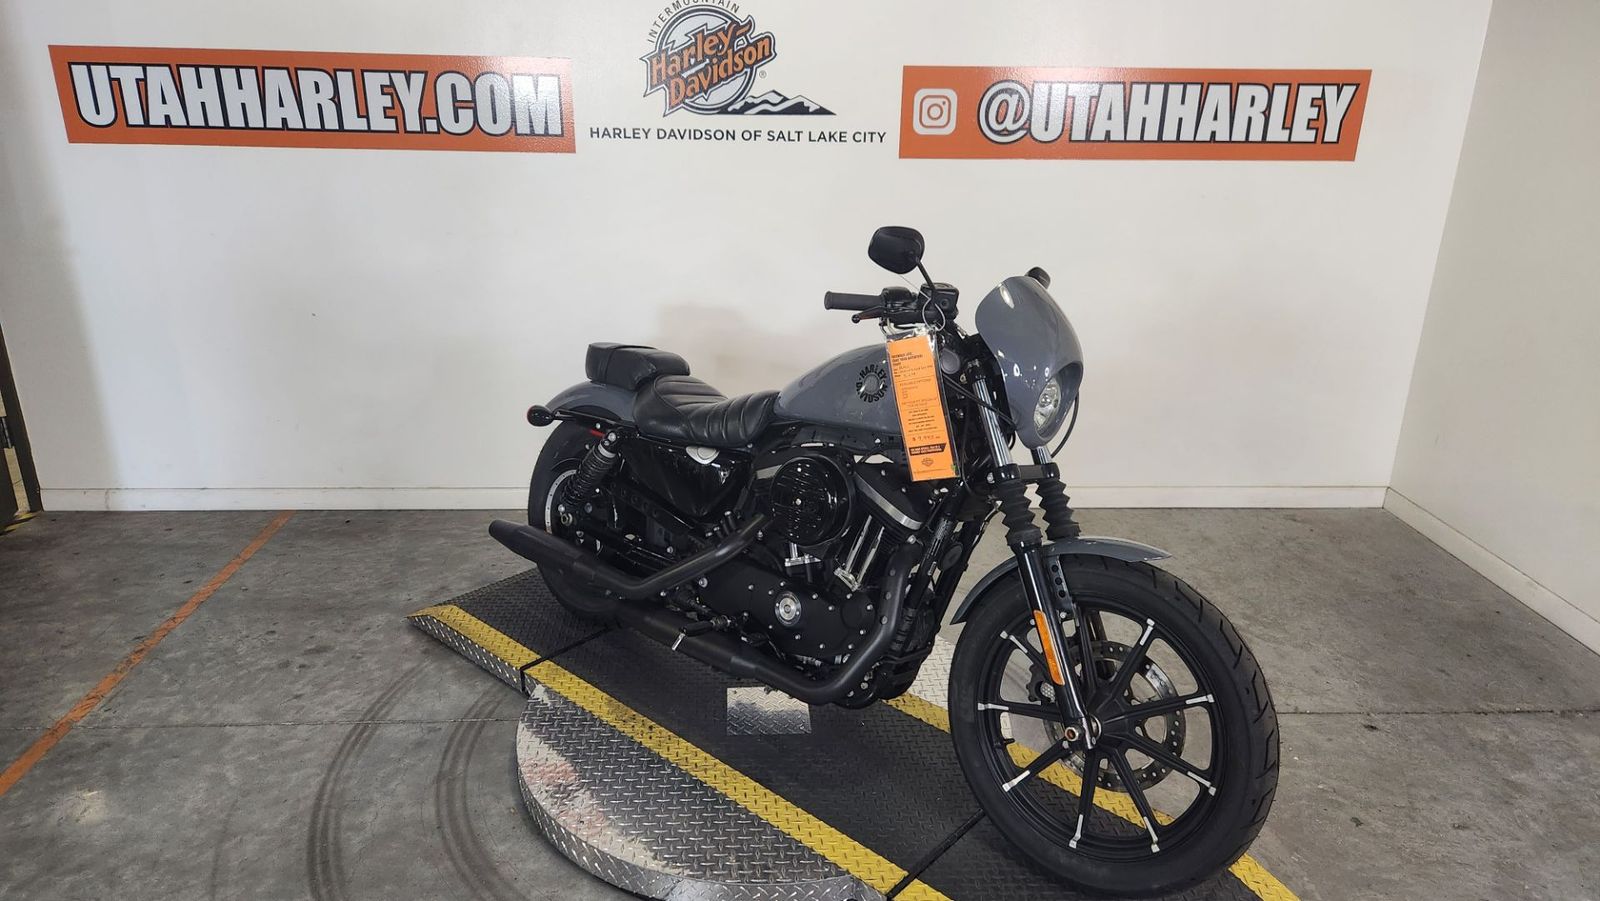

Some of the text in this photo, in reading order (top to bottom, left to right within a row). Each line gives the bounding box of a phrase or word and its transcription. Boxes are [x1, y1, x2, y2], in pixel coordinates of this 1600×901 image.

[647, 0, 740, 44] INTERMOAIN
[68, 62, 565, 137] UTAHHARLEY.COM
[669, 38, 770, 107] Davidson
[590, 127, 887, 143] HARLEY DAVIDSON OF SALT LAKE CITY
[976, 79, 1358, 145] @UTAHHARLEY
[859, 364, 888, 381] HARLEY
